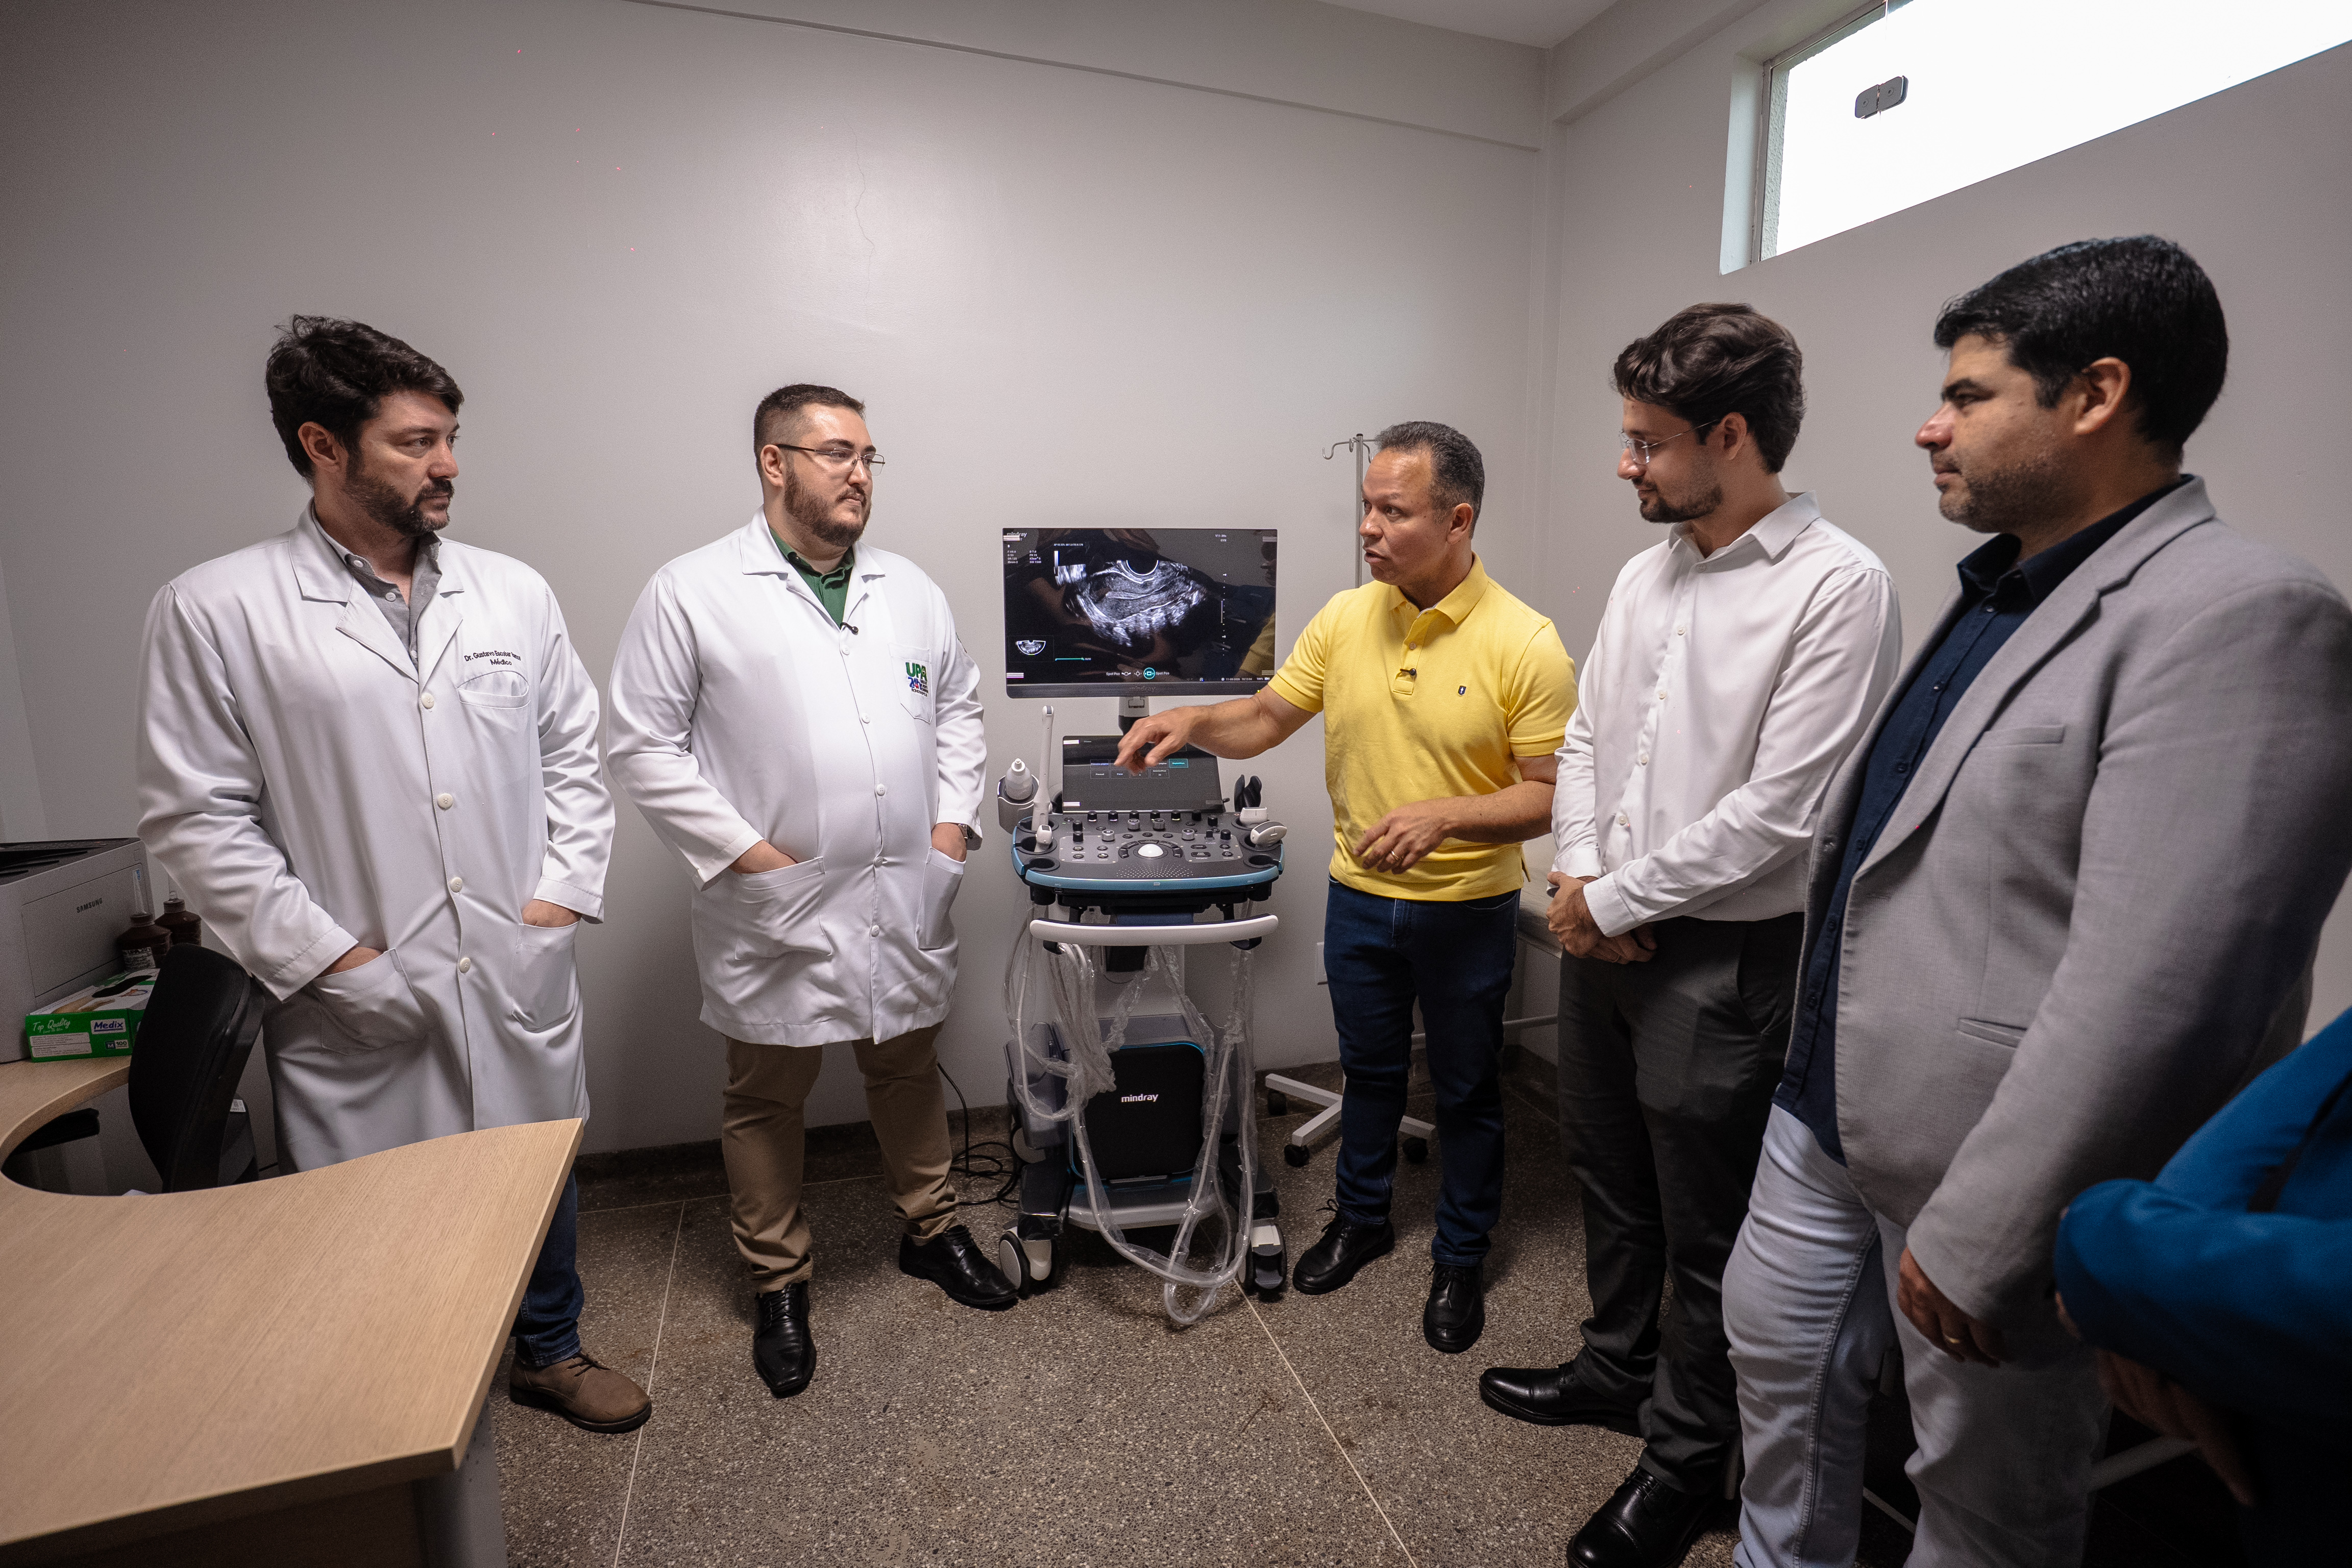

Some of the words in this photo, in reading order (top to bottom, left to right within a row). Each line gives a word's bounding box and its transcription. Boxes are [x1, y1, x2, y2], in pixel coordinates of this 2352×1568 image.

[905, 662, 928, 682] UPA
[76, 898, 103, 913] SAMSUNG
[33, 1022, 44, 1033] Top
[47, 1018, 70, 1029] Quality
[94, 1021, 124, 1030] Medix
[1121, 1093, 1159, 1102] mindray
